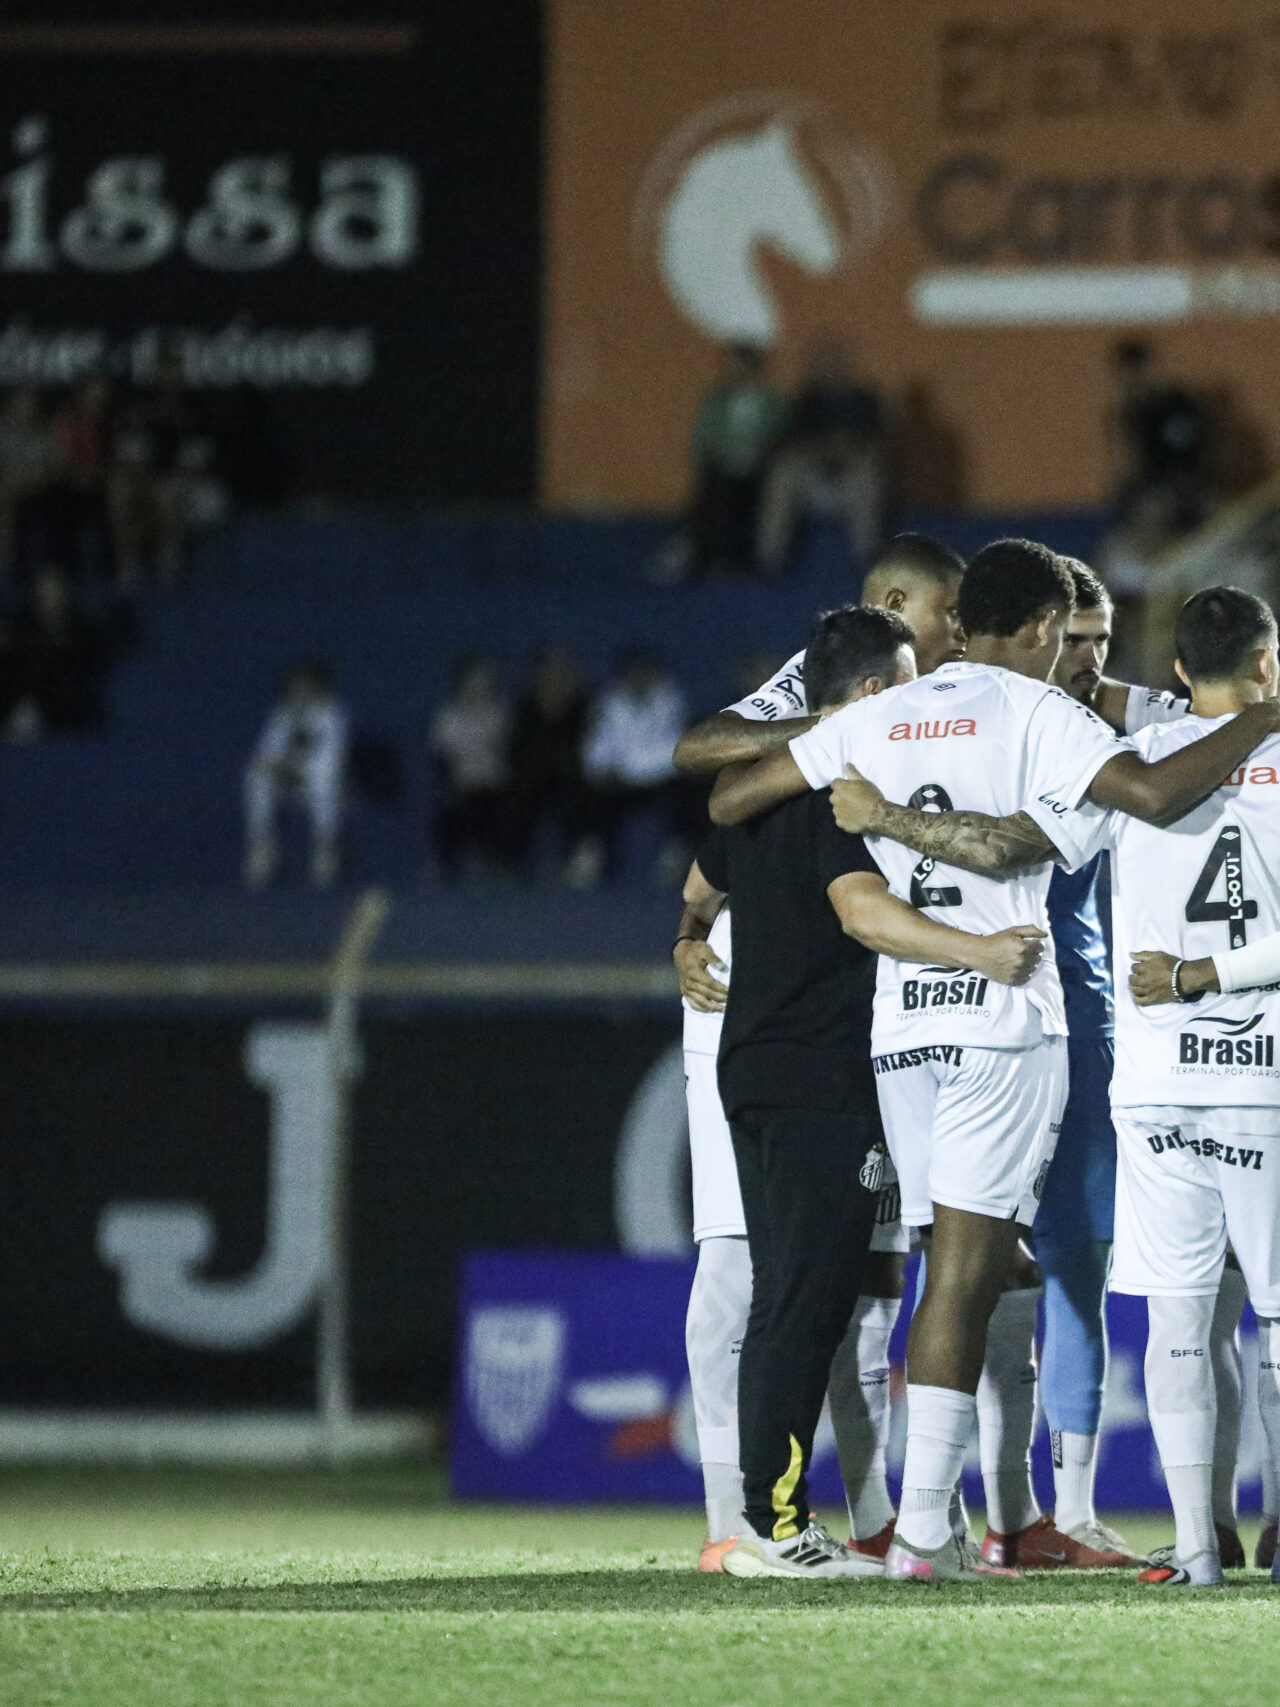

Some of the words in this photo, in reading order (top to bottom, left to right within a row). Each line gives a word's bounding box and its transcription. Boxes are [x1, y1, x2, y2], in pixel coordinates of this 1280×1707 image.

[888, 718, 977, 741] aiwa
[1185, 825, 1258, 950] 4
[903, 977, 989, 1010] Brasil
[1180, 1033, 1274, 1067] Brasil
[1171, 1066, 1221, 1076] TERMINAL
[1170, 1348, 1204, 1358] SFC
